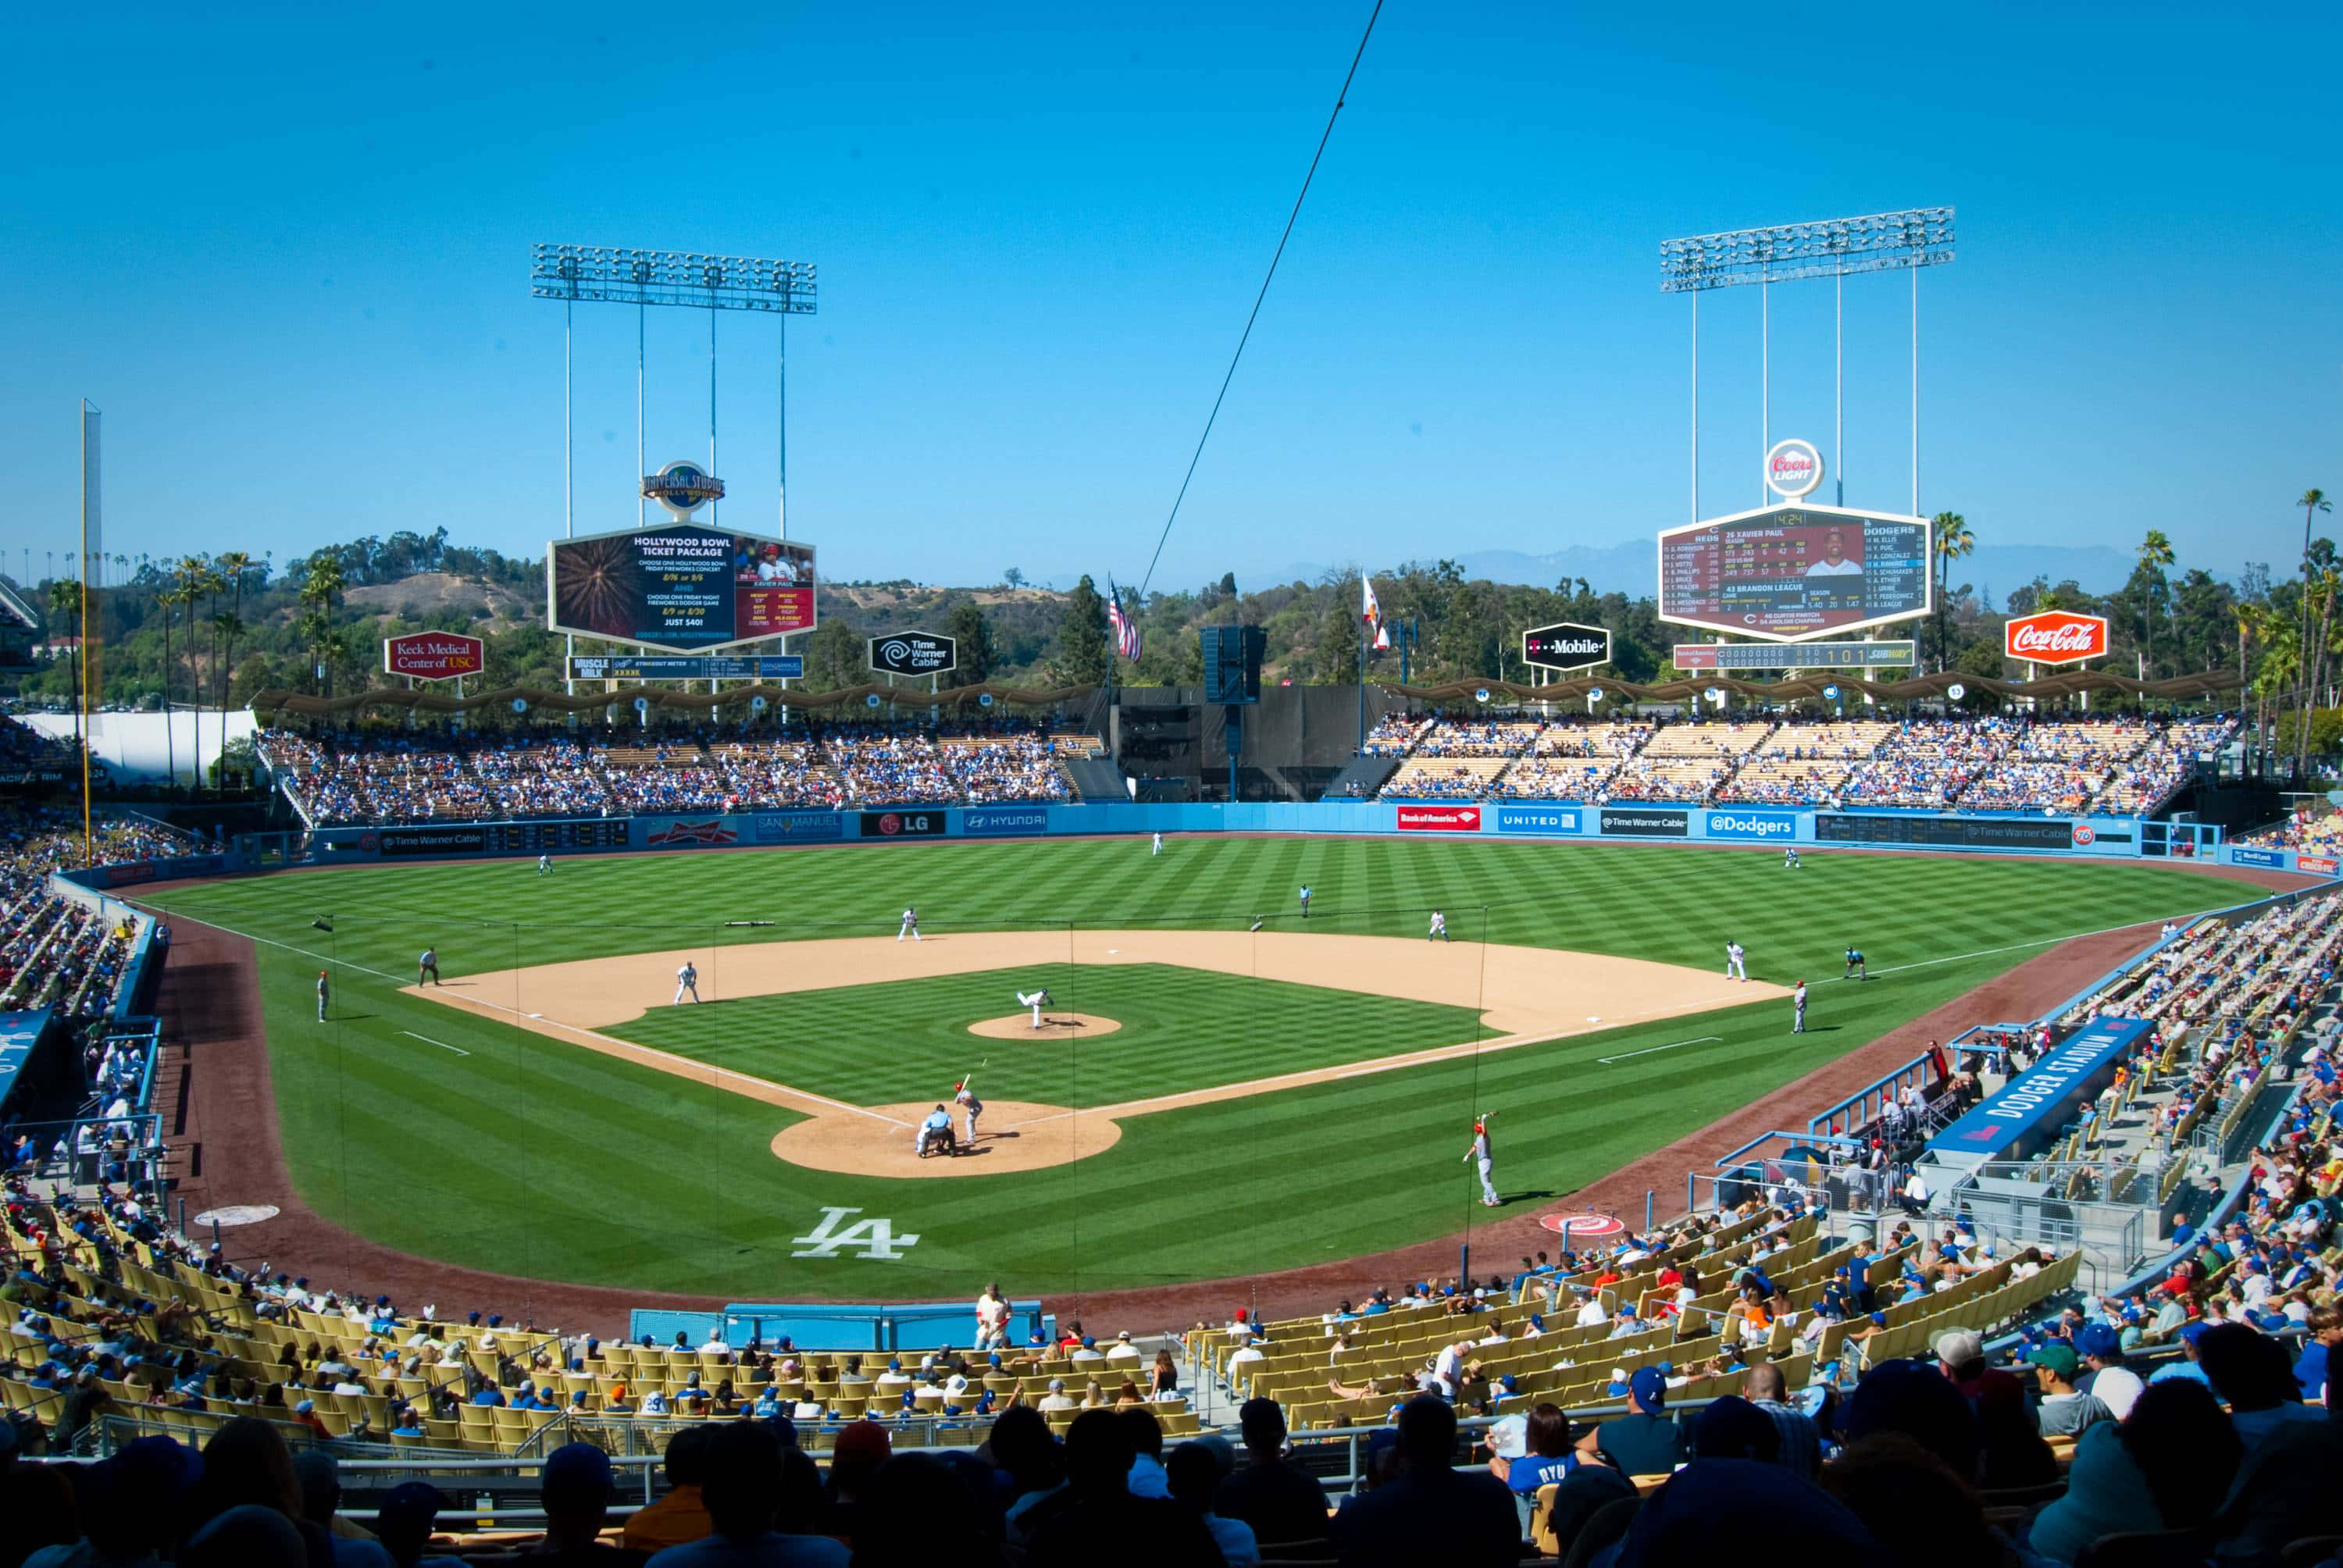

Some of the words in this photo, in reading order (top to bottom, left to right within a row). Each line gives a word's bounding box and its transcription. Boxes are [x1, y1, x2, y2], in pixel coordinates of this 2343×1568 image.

[1773, 456, 1812, 472] Coors
[1774, 470, 1810, 480] LIGHT
[644, 475, 690, 490] UNIVERSAL
[692, 475, 726, 493] STUDIOS
[654, 489, 720, 499] HOLLYWOOD
[1778, 514, 1803, 525] 4:24
[1864, 526, 1915, 536] DODGERS
[634, 537, 699, 547] HOLLYWOOD
[701, 538, 731, 547] BOWL
[2013, 623, 2097, 651] Coca-Cola
[398, 643, 424, 654] Keck
[428, 643, 469, 654] Medical
[911, 640, 936, 649] Time
[911, 650, 947, 658] Warner
[1869, 649, 1911, 659] SUBWAY
[398, 657, 434, 668] Center
[435, 657, 448, 668] of
[449, 657, 475, 668] USC
[574, 658, 609, 668] MUSCLE
[911, 657, 940, 667] Cable
[580, 668, 603, 678] MILK
[758, 818, 781, 827] SAN
[790, 816, 840, 827] MANUEL
[991, 815, 1046, 825] HYUNDAI
[1400, 814, 1418, 822] Bank
[1418, 814, 1428, 822] of
[1427, 814, 1457, 822] America
[1504, 816, 1558, 825] UNITED
[1613, 818, 1632, 826] Time
[1633, 818, 1660, 827] Warner
[1661, 819, 1685, 828] Cable
[904, 817, 928, 831] LG
[1711, 815, 1791, 836] @Dodgers
[1980, 826, 2003, 838] Time
[2005, 828, 2041, 838] Warner
[2042, 828, 2070, 839] Cable
[2074, 829, 2093, 842] 76
[394, 836, 418, 846] Time
[419, 835, 453, 844] Warner
[455, 833, 481, 843] Cable
[1986, 1074, 2068, 1118] DODGER
[2046, 1035, 2118, 1073] STADIUM
[791, 1206, 921, 1259] LA
[1539, 1464, 1566, 1484] RYU
